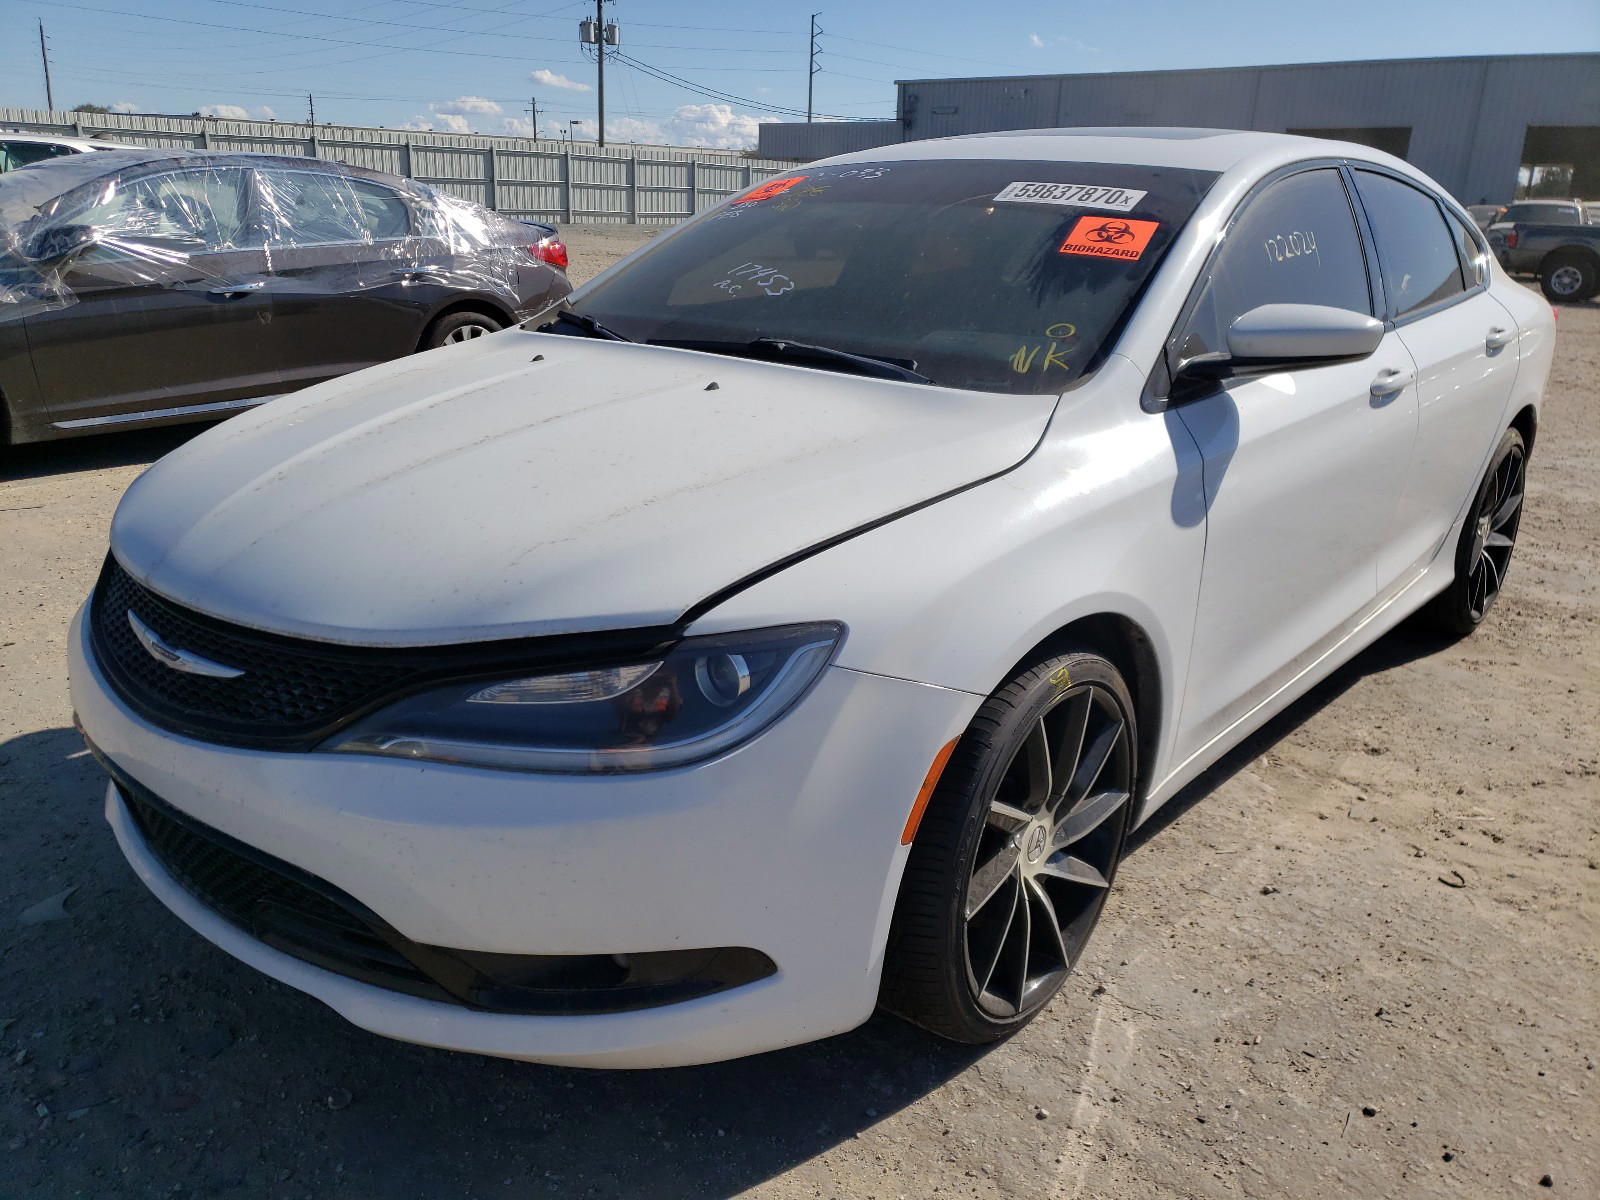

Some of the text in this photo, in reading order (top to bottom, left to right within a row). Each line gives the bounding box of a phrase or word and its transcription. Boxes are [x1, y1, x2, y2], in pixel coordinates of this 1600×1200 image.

[1013, 183, 1126, 205] 59837870
[1063, 244, 1139, 258] BIOHAZARD
[1264, 231, 1321, 268] 122024
